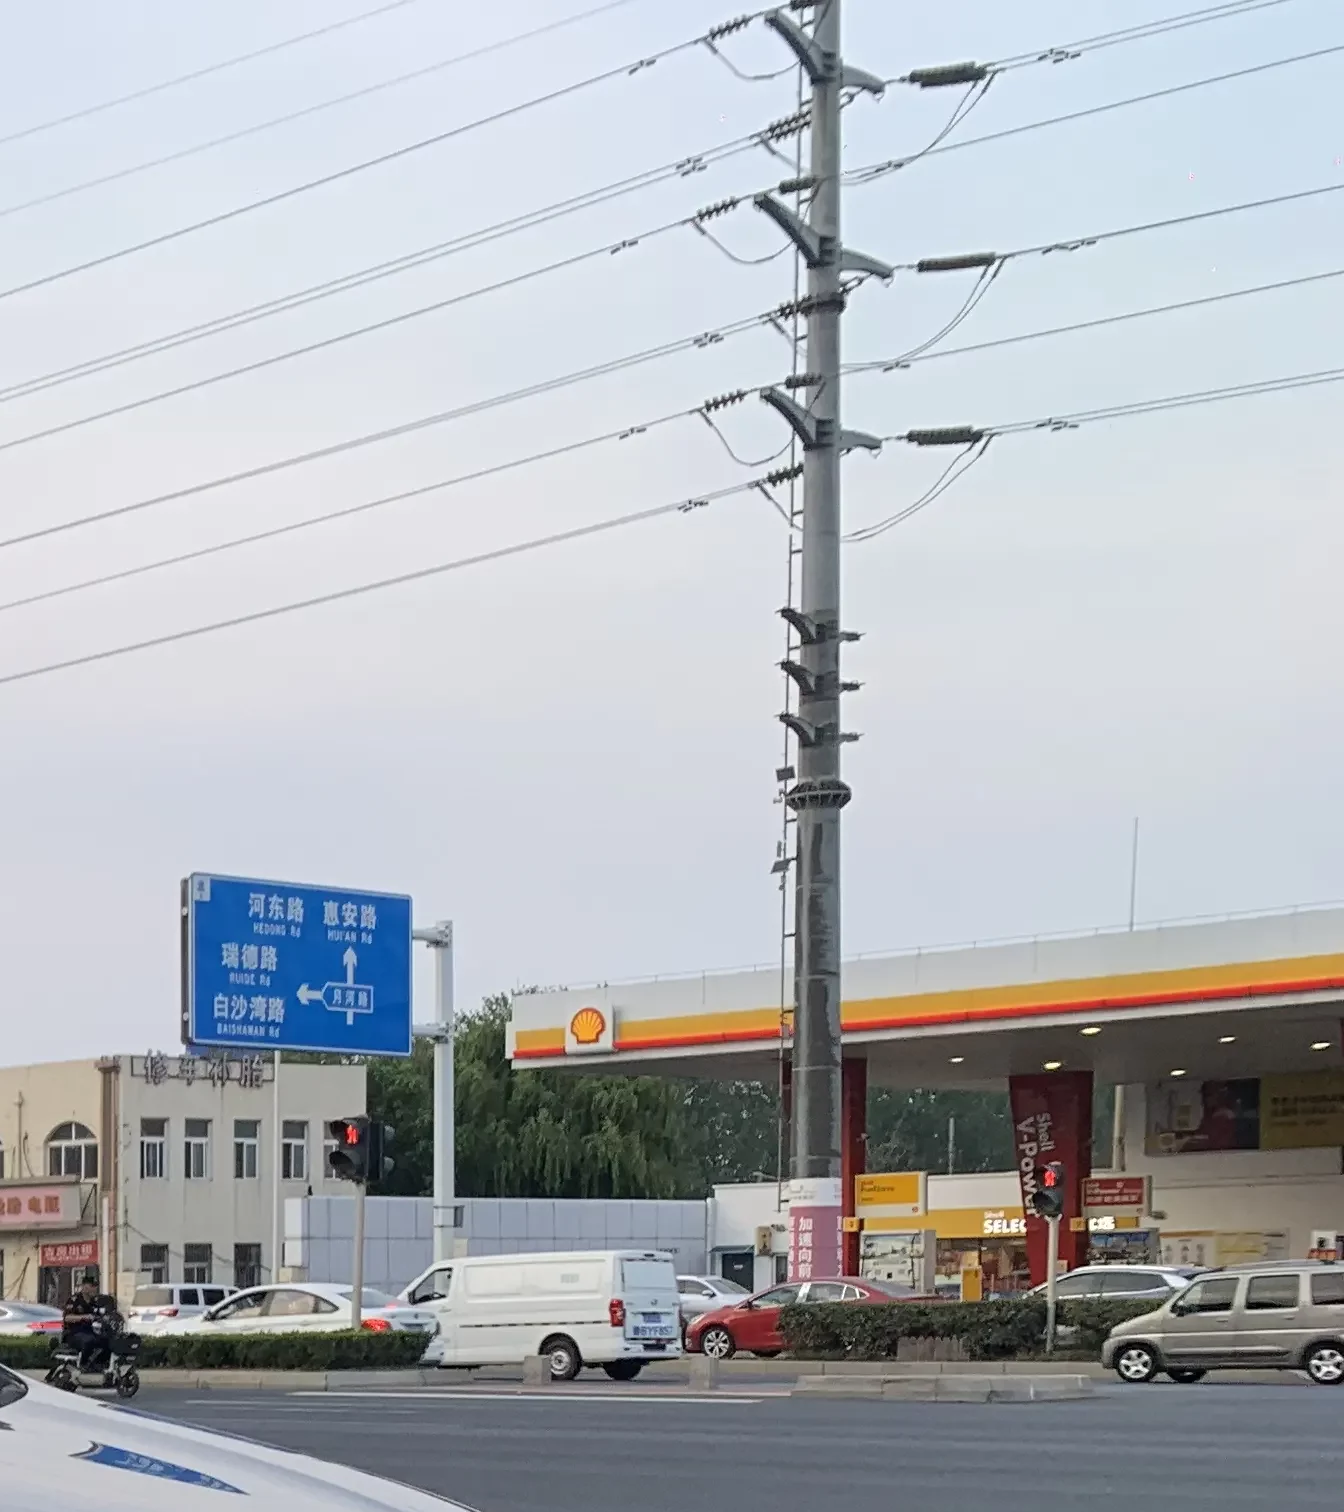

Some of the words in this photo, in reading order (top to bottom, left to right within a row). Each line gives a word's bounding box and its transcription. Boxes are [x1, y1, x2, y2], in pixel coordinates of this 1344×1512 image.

[248, 892, 304, 923] 河东路
[322, 900, 377, 930] 惠安路
[253, 921, 286, 937] HEDONG
[221, 942, 278, 972] 瑞德路
[213, 993, 285, 1024] 白沙湾路
[144, 1050, 264, 1089] 修车补胎
[1036, 1112, 1056, 1151] Shell
